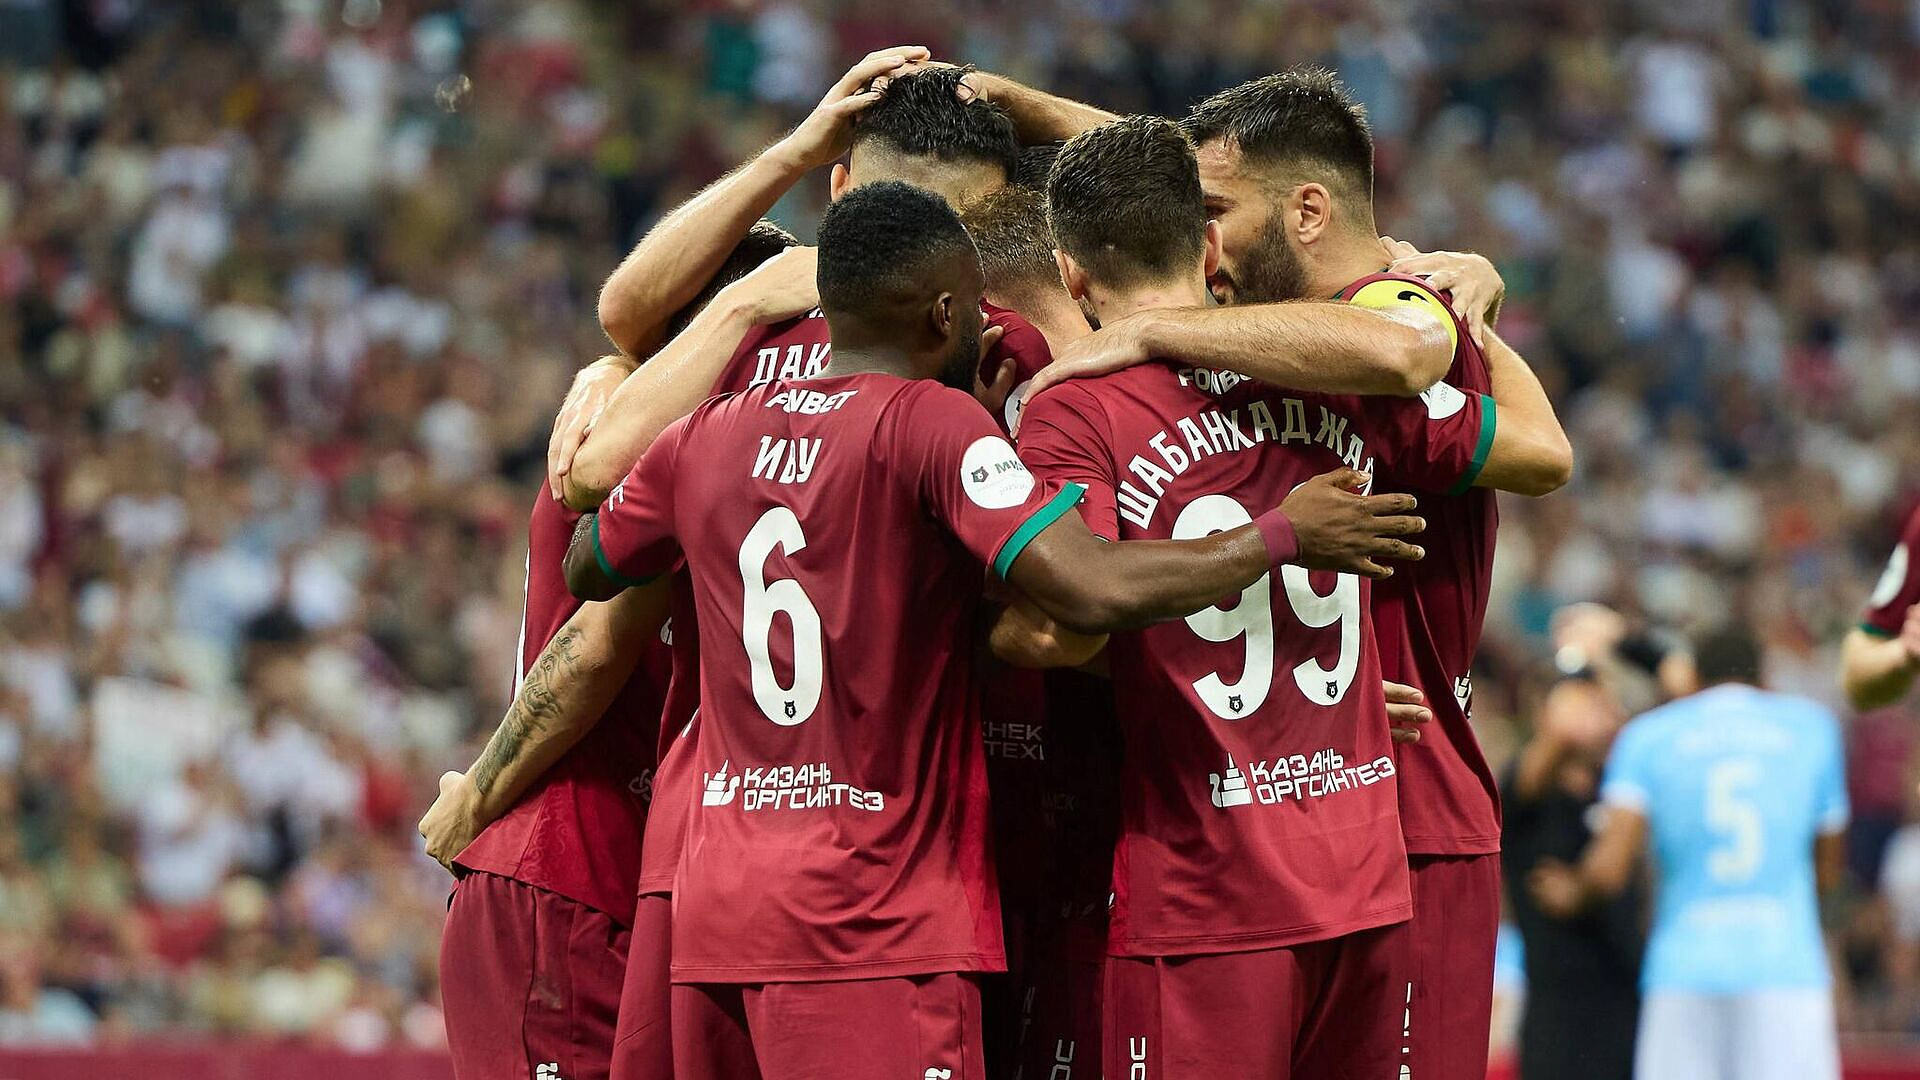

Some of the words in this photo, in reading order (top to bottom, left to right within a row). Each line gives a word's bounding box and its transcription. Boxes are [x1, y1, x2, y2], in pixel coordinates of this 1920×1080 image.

[738, 506, 823, 727] 6
[1171, 481, 1360, 720] 99
[743, 762, 832, 788] КАЗАНЬ
[1250, 748, 1344, 784] КАЗАНЬ
[1255, 756, 1396, 805] ОРГСИНТЕЗ
[743, 784, 885, 811] ОРГСИНТЕЗ
[1707, 759, 1763, 883] 5
